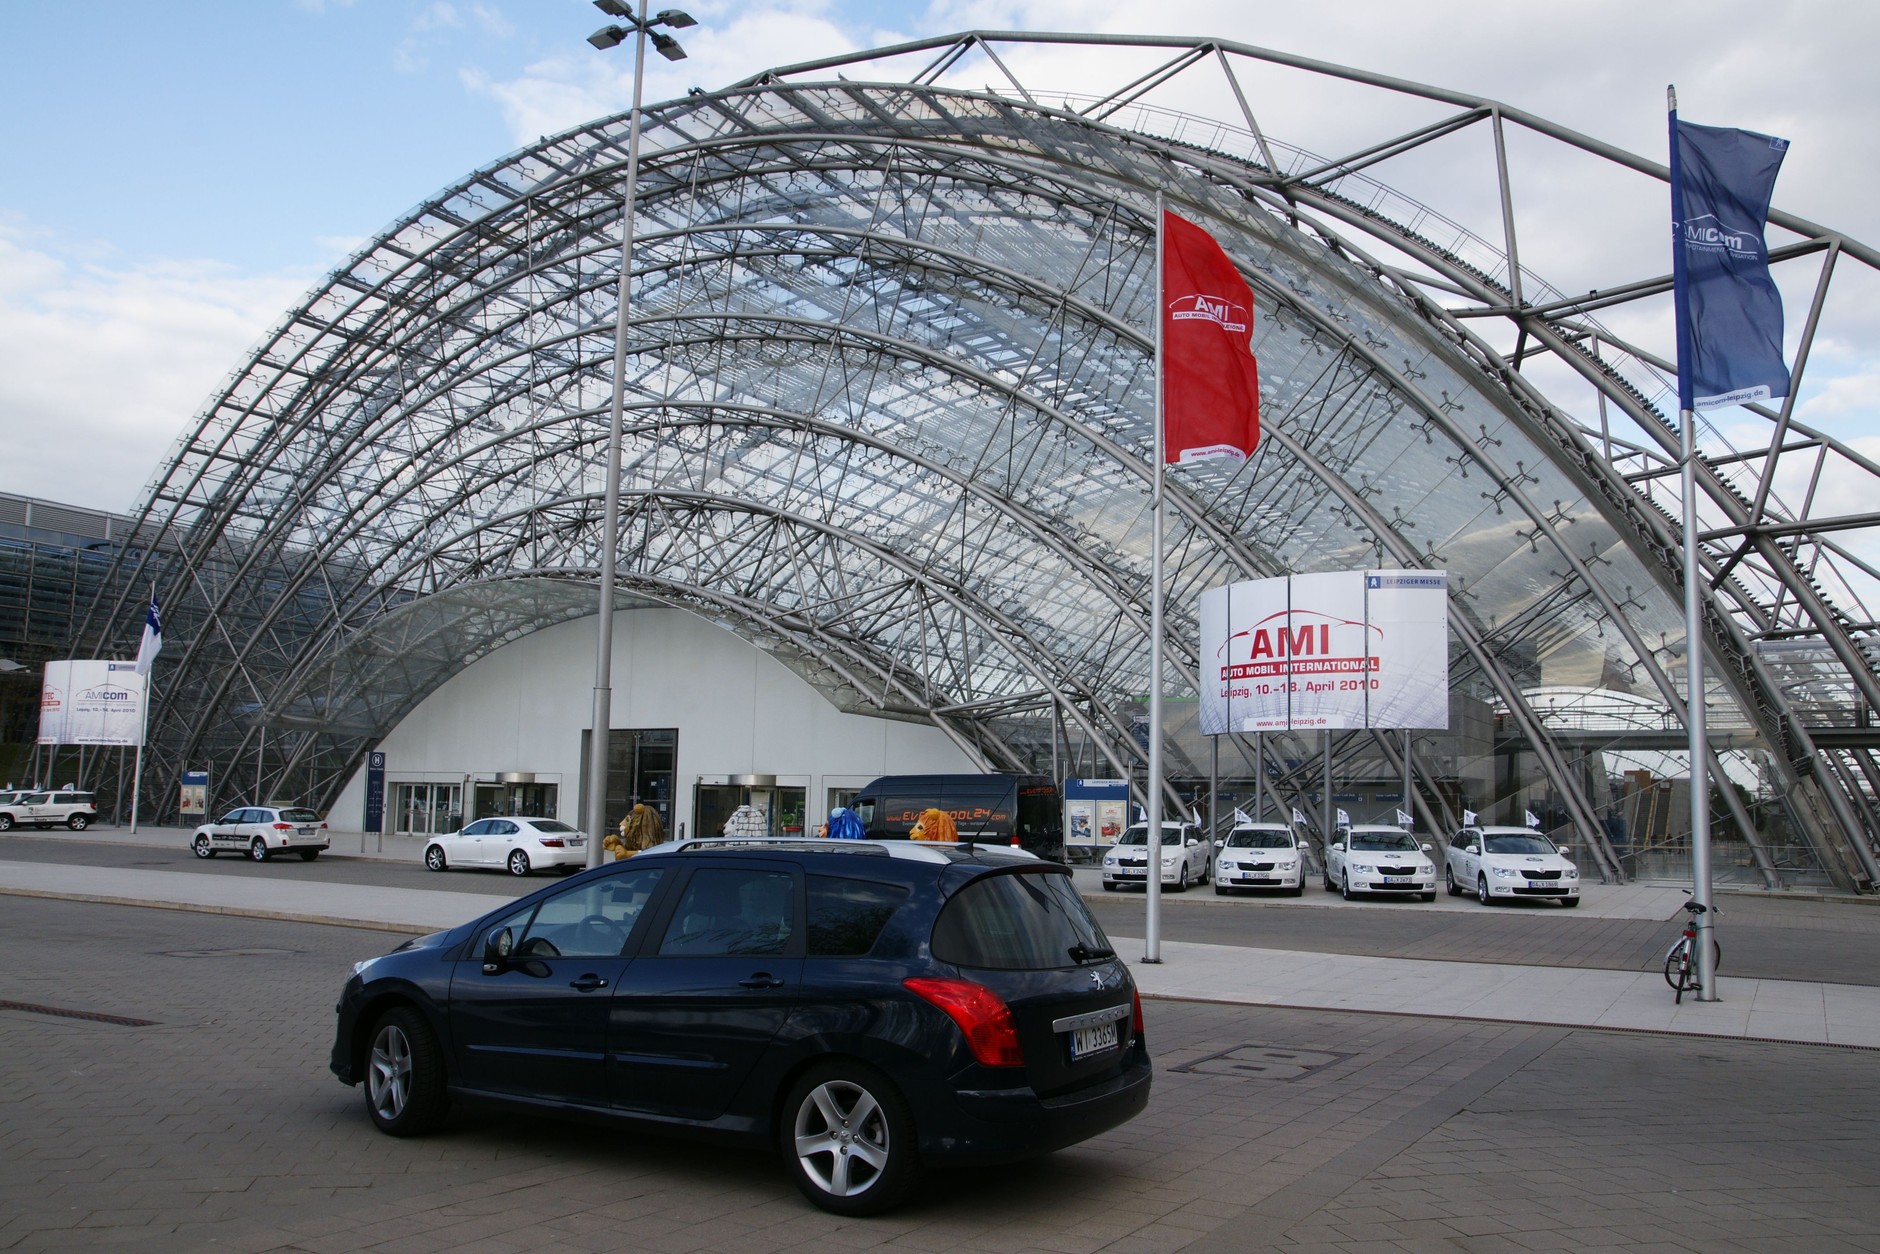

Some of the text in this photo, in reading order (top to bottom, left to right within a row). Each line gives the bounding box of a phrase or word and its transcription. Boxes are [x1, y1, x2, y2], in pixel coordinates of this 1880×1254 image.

[1194, 296, 1229, 322] AMI
[1386, 578, 1441, 586] LEIPZIGER MESSE
[1250, 623, 1330, 660] AMI
[1222, 660, 1378, 679] AUTO MOBIL INTERNATIONAL
[85, 691, 128, 701] AMIcom
[1220, 685, 1253, 699] Leipzig,
[1305, 680, 1335, 694] April
[1339, 679, 1380, 692] 2010
[1075, 1029, 1089, 1053] WI
[1091, 1020, 1118, 1048] 3365M
